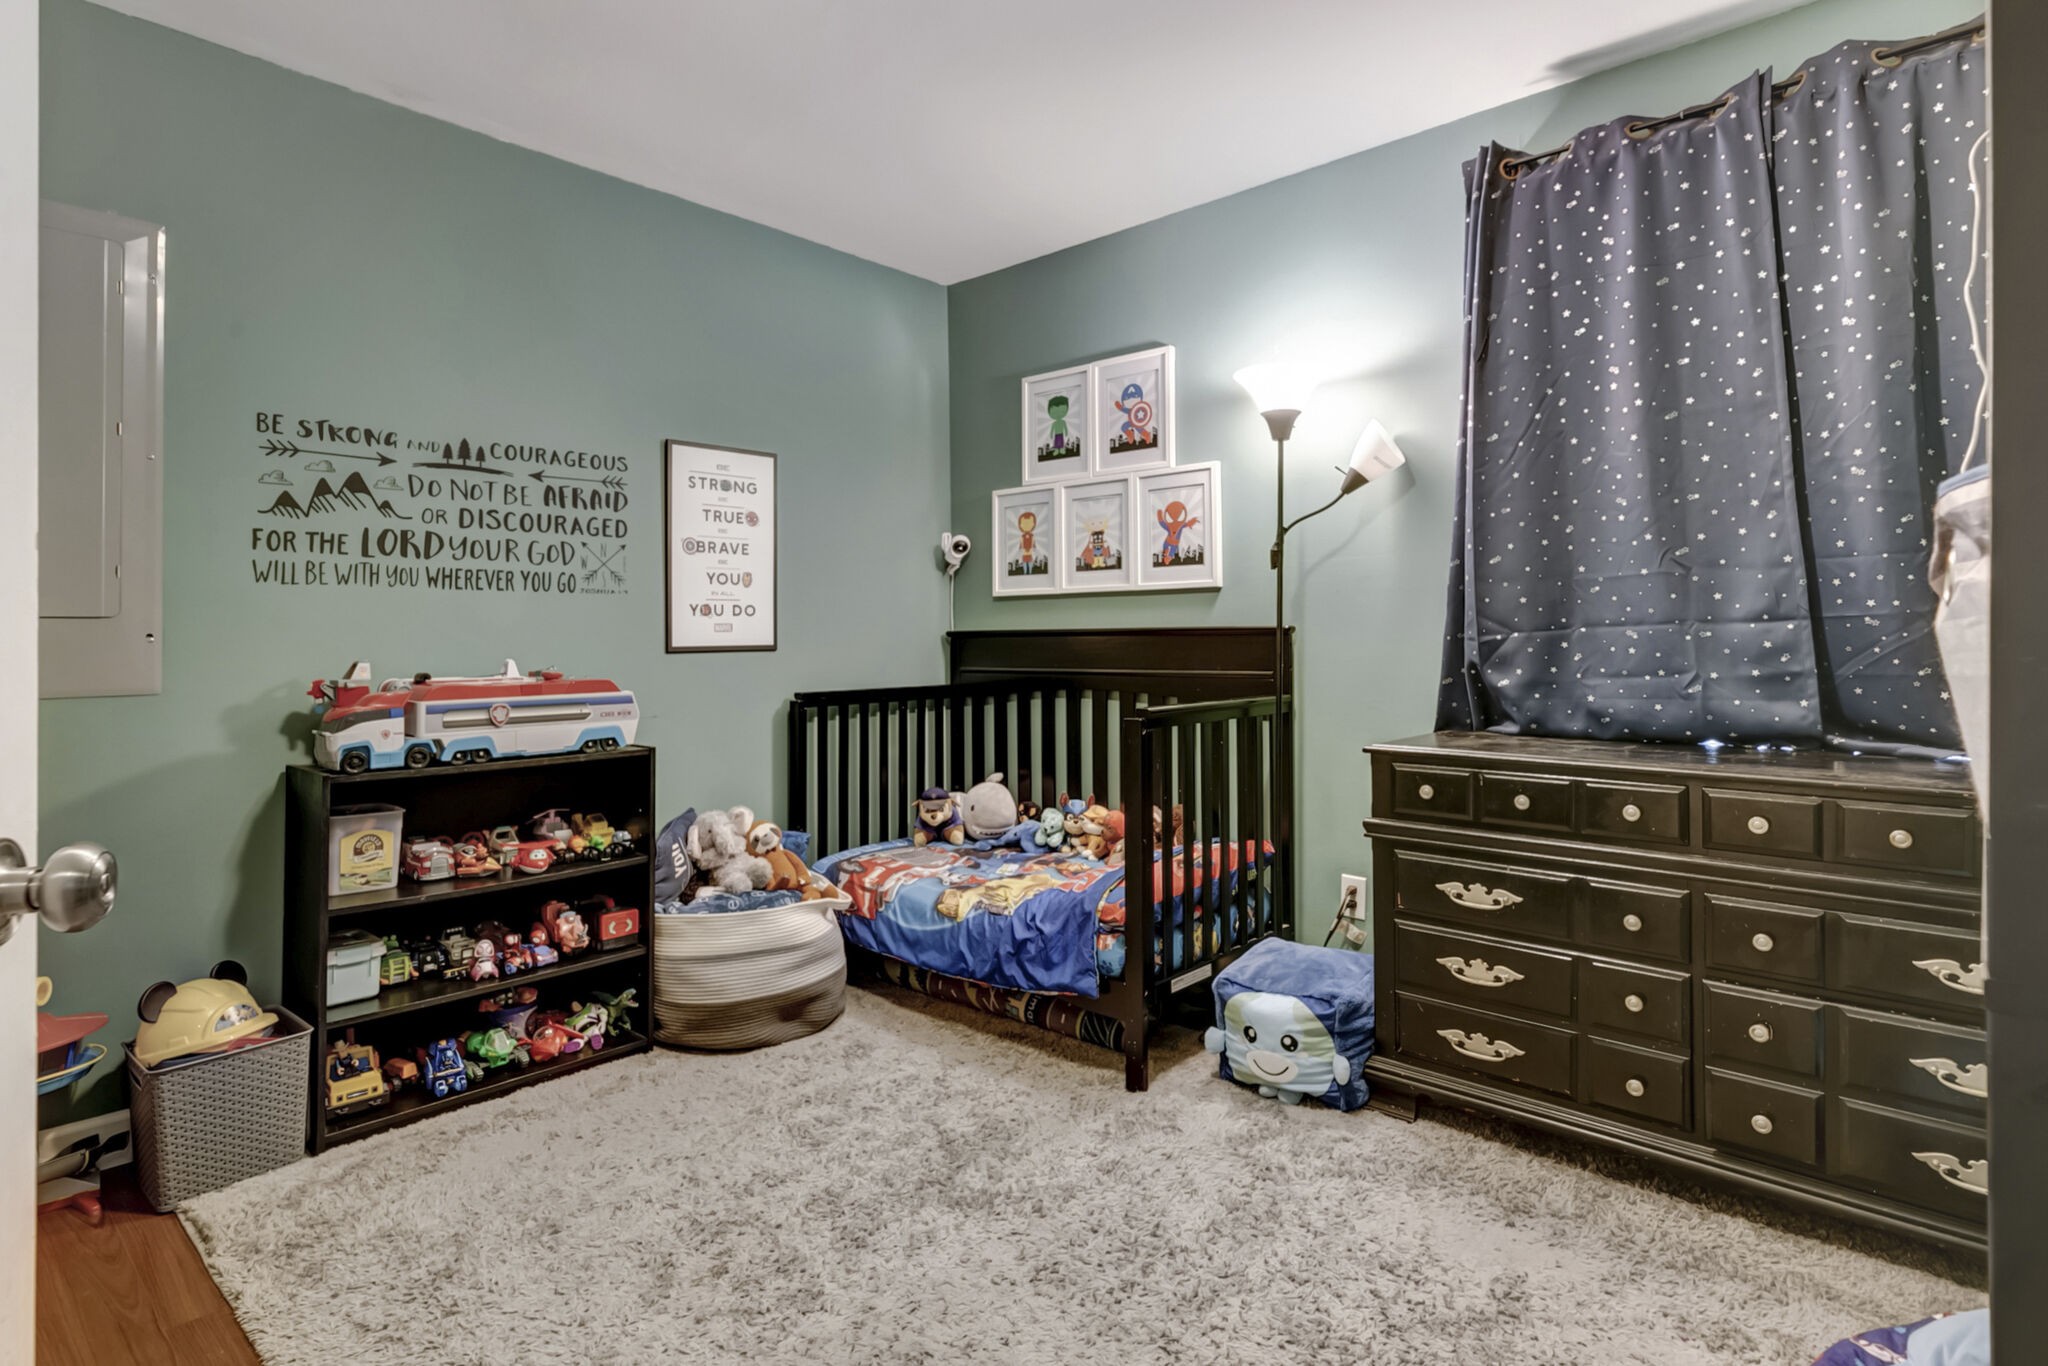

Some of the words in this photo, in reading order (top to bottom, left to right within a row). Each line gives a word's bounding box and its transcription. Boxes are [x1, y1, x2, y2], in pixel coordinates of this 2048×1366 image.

[256, 412, 284, 434] BE
[296, 419, 398, 448] STRONG
[407, 439, 440, 453] AND
[490, 442, 629, 472] COURAGEOUS
[408, 474, 442, 498] DO
[450, 479, 498, 502] NOT
[504, 484, 532, 507] BE
[543, 485, 629, 512] AFRAID
[421, 508, 448, 525] OR
[458, 508, 628, 538] DISCOURAGED
[702, 509, 744, 524] TRUE
[252, 528, 296, 552] FOR
[305, 532, 349, 555] THE
[361, 527, 444, 560] LORD
[449, 536, 520, 563] YOUR
[528, 539, 575, 566] GOD
[696, 540, 750, 556] BRAVE
[252, 560, 300, 585] WILL
[306, 560, 328, 585] BE
[334, 562, 380, 587] WITH
[386, 565, 420, 588] YOU
[426, 566, 515, 592] WHEREVER
[520, 570, 552, 593] YOU
[557, 572, 576, 594] GO
[706, 572, 741, 586] YOU
[689, 604, 724, 617] YOU
[732, 604, 756, 617] DO
